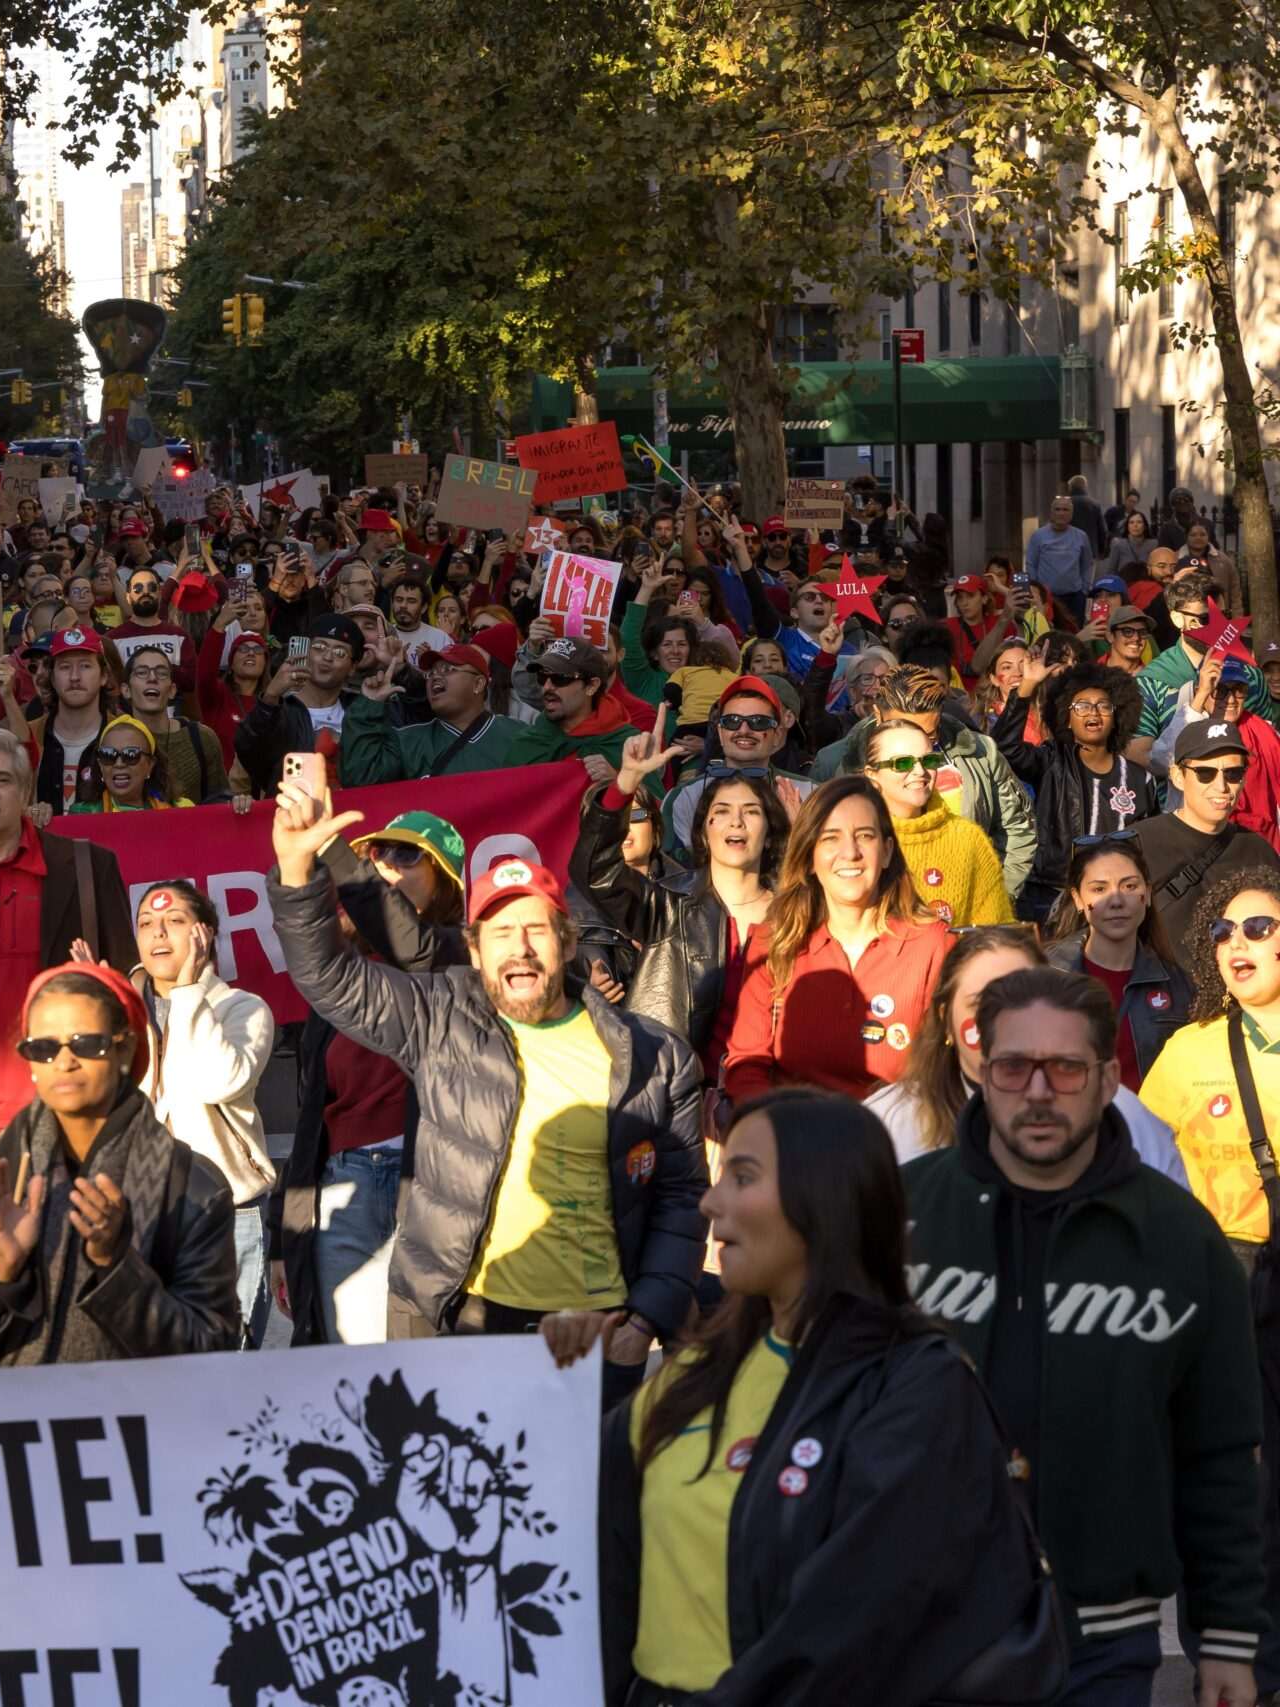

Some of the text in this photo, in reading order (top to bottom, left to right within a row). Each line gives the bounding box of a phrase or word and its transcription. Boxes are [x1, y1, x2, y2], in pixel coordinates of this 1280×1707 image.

[666, 421, 689, 433] ne
[450, 459, 533, 496] BRASIL
[536, 529, 551, 545] 13
[835, 582, 868, 597] LULA
[1214, 623, 1239, 652] LULA
[230, 1516, 408, 1632] #DEFEND
[277, 1554, 442, 1655] DEMOCRACY
